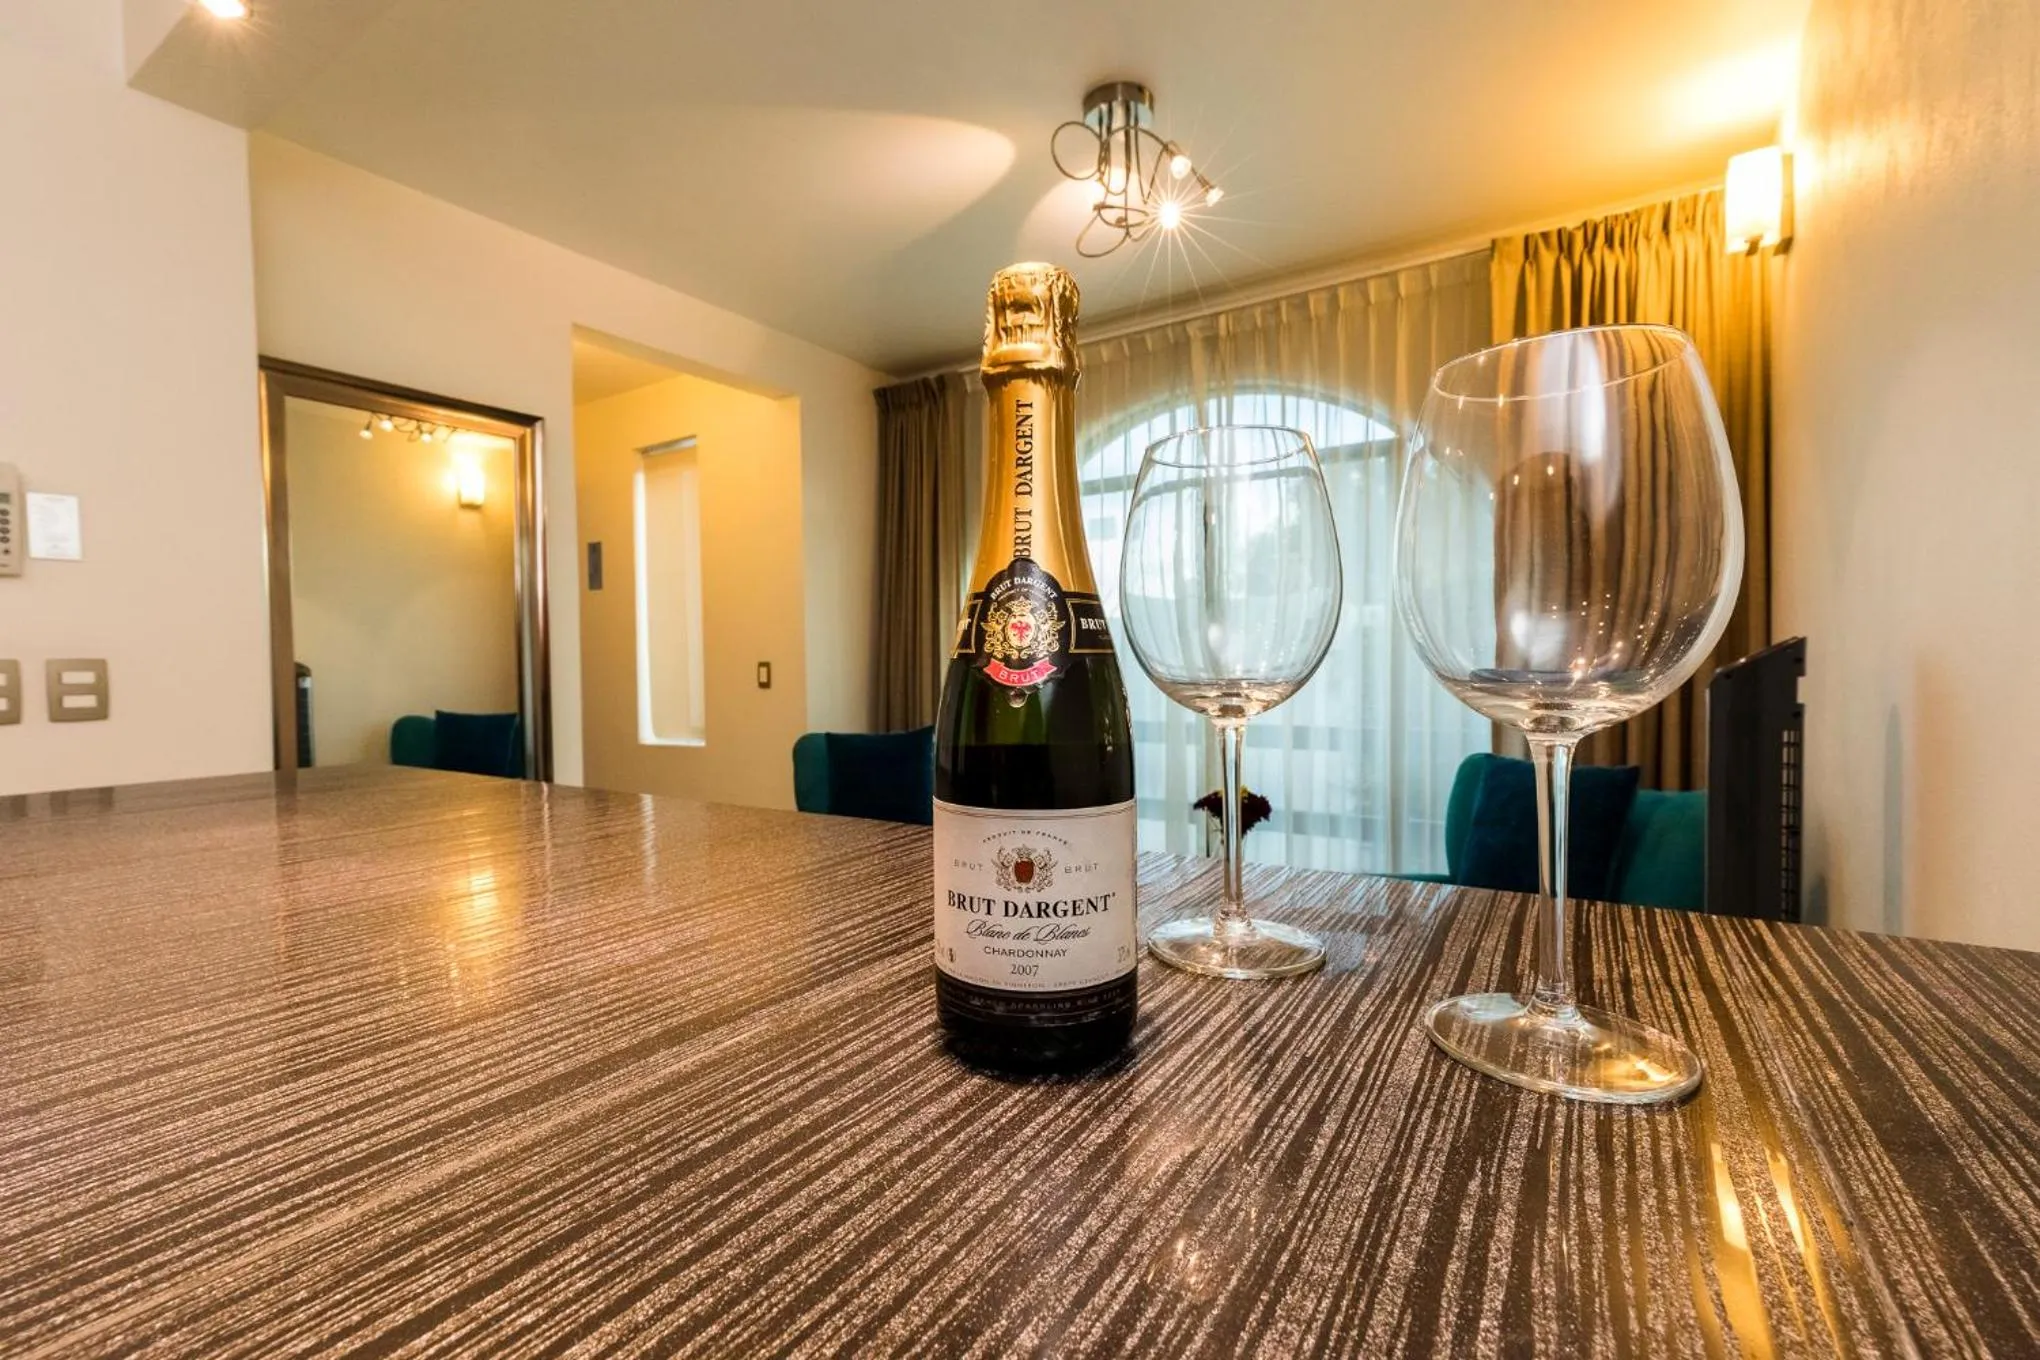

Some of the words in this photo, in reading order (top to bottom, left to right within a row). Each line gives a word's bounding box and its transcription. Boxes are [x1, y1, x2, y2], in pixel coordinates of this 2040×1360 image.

[1015, 399, 1034, 498] DARGENT
[1013, 507, 1033, 559] BRUT
[990, 579, 1012, 600] BRUT
[1013, 576, 1059, 599] DARGENT
[999, 671, 1042, 684] BRUT
[953, 858, 984, 872] BRUT
[1064, 861, 1100, 874] BRUT
[947, 889, 996, 916] BRUT
[1003, 894, 1112, 919] DARGENT
[966, 918, 1011, 940] Blanc
[1012, 926, 1032, 941] de
[1033, 922, 1091, 945] Blancs
[983, 945, 1069, 959] CHARDONNAY
[1011, 963, 1041, 978] 2007
